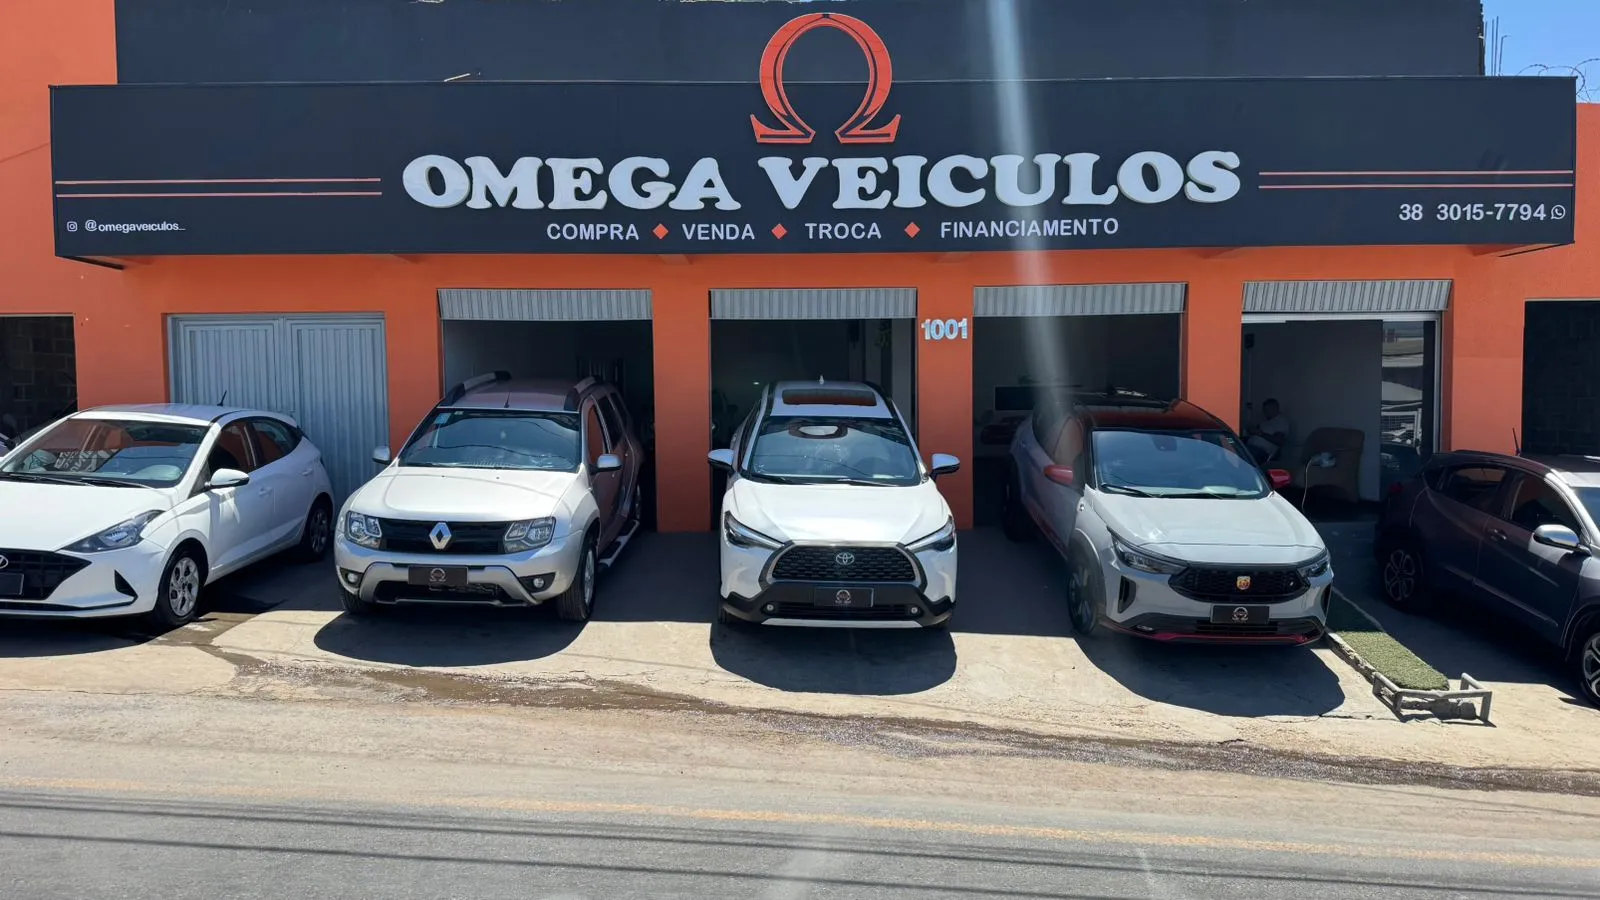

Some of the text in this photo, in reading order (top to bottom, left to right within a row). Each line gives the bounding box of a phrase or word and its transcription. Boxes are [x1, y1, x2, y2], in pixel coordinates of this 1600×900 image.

[403, 150, 1241, 211] OMEGA VEICULOS
[1399, 203, 1546, 221] 38 3015-7794
[546, 217, 1119, 241] COMPRA VENDA TROCA FINANCIAMENTO
[921, 318, 968, 340] 1001
